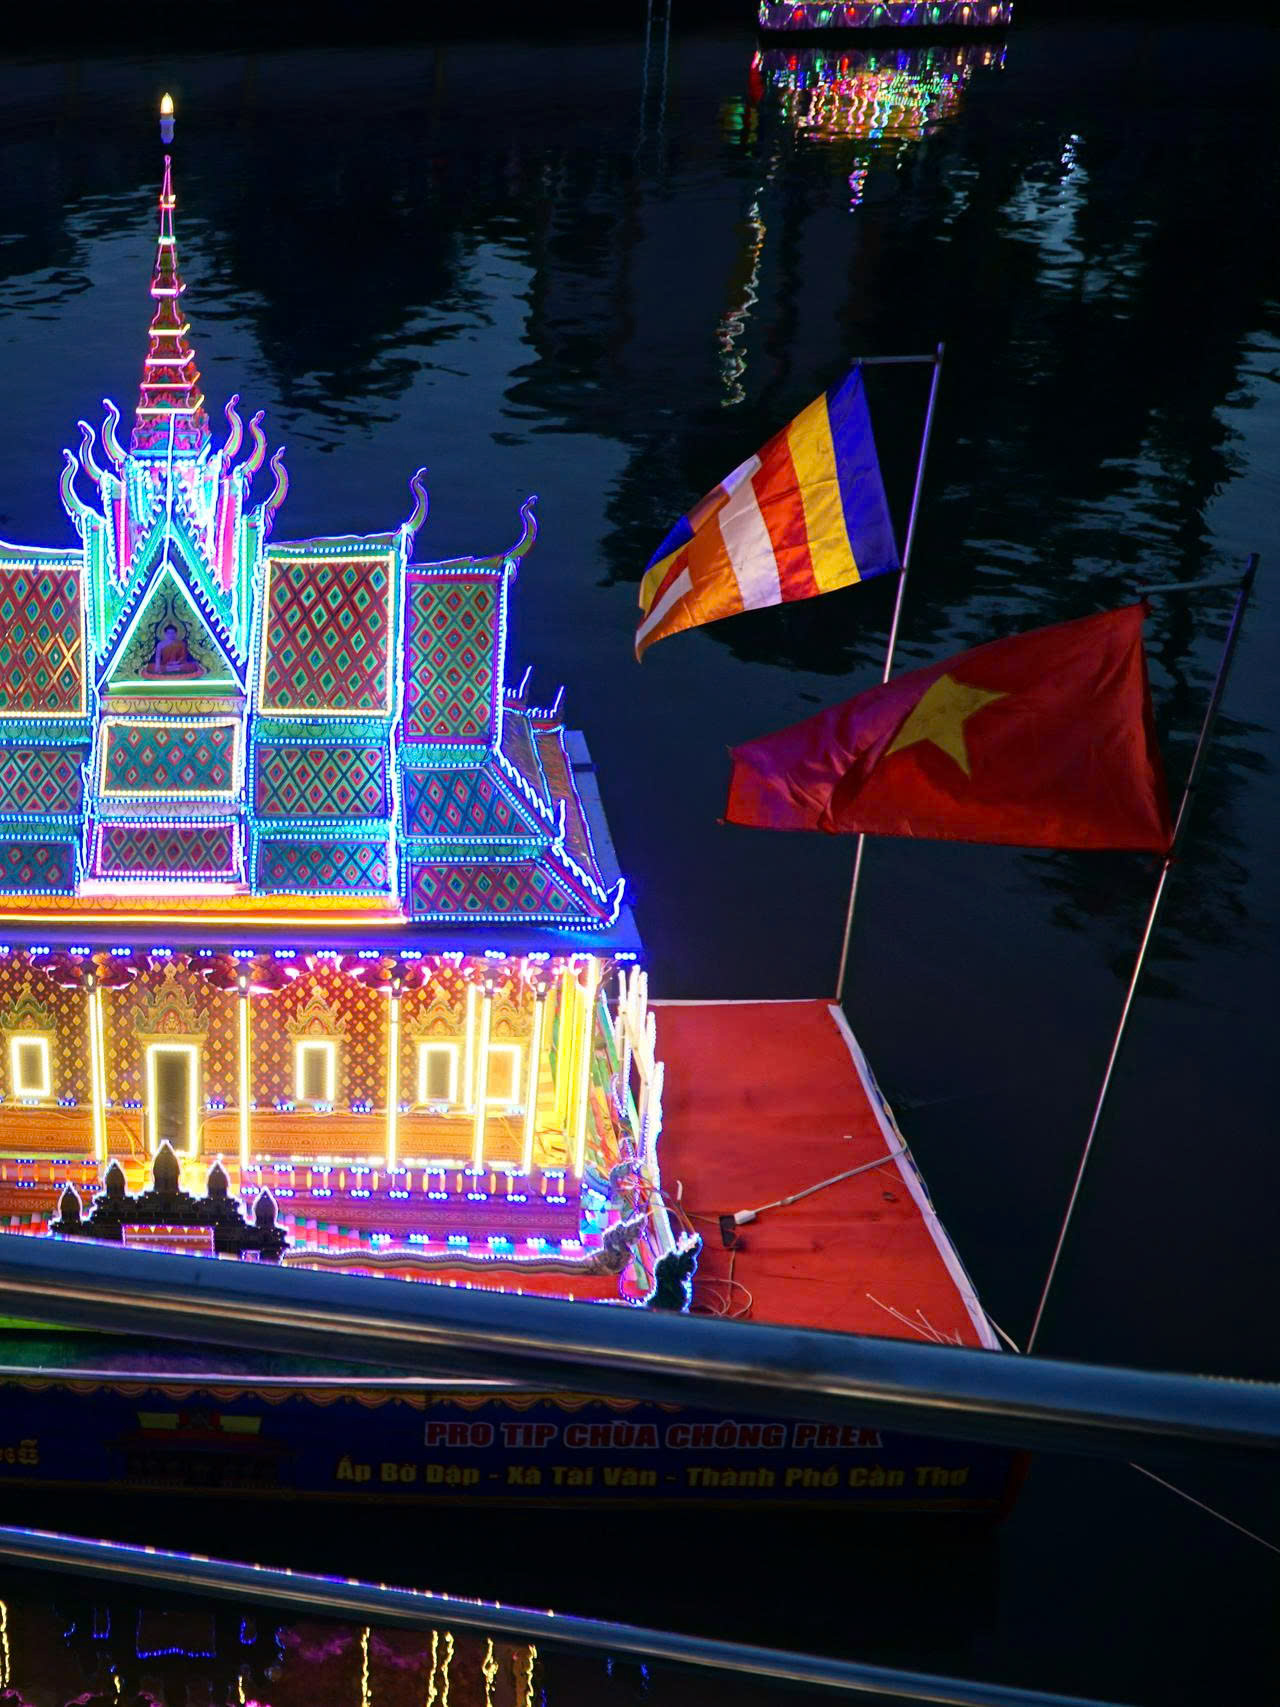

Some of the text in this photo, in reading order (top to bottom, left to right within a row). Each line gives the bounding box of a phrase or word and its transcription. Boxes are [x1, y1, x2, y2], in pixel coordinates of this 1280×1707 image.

[424, 1421, 494, 1447] PRO
[500, 1422, 558, 1448] TIP
[563, 1419, 660, 1449] CHÙA
[664, 1419, 787, 1449] CHÔNG
